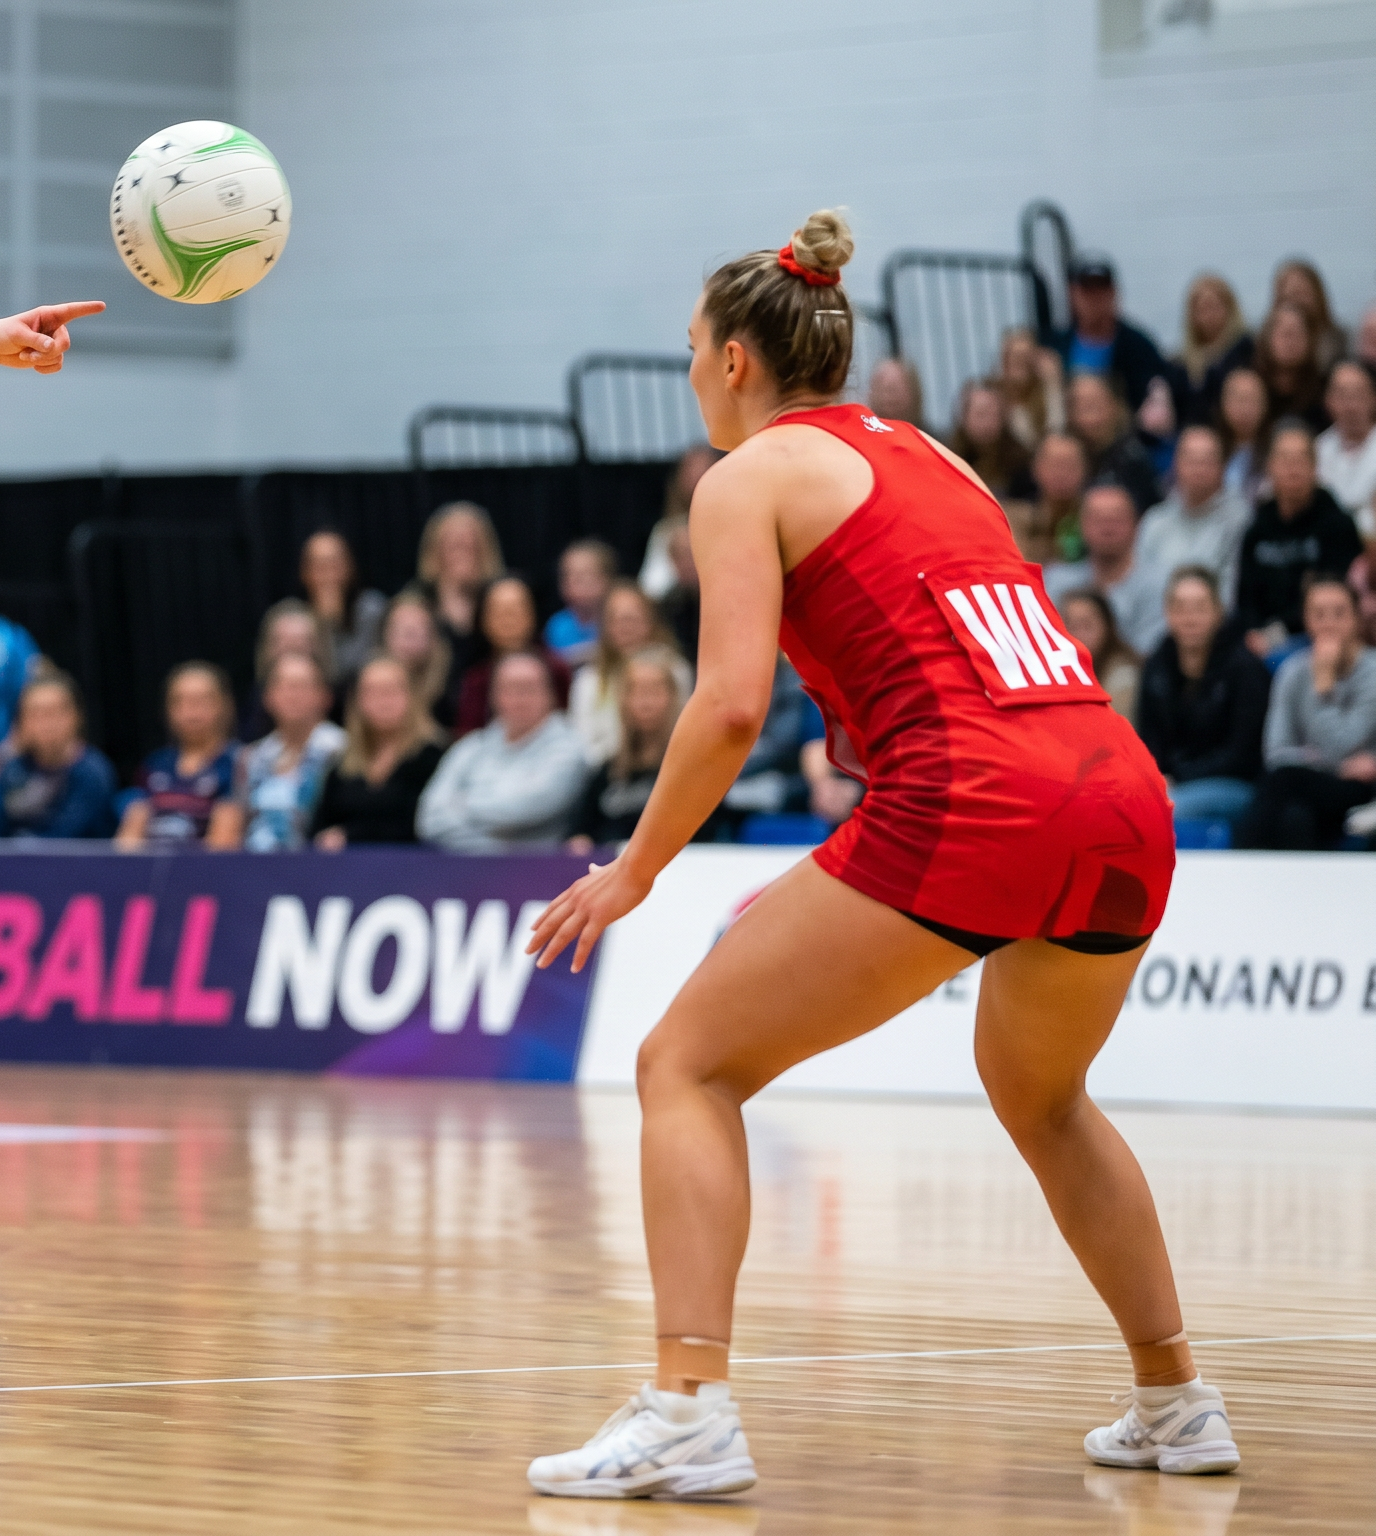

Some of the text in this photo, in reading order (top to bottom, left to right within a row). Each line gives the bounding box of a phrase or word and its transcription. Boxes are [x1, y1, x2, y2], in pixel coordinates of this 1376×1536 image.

[944, 583, 1093, 690] WA
[244, 894, 550, 1036] NOW
[1126, 957, 1344, 1011] ONAND
